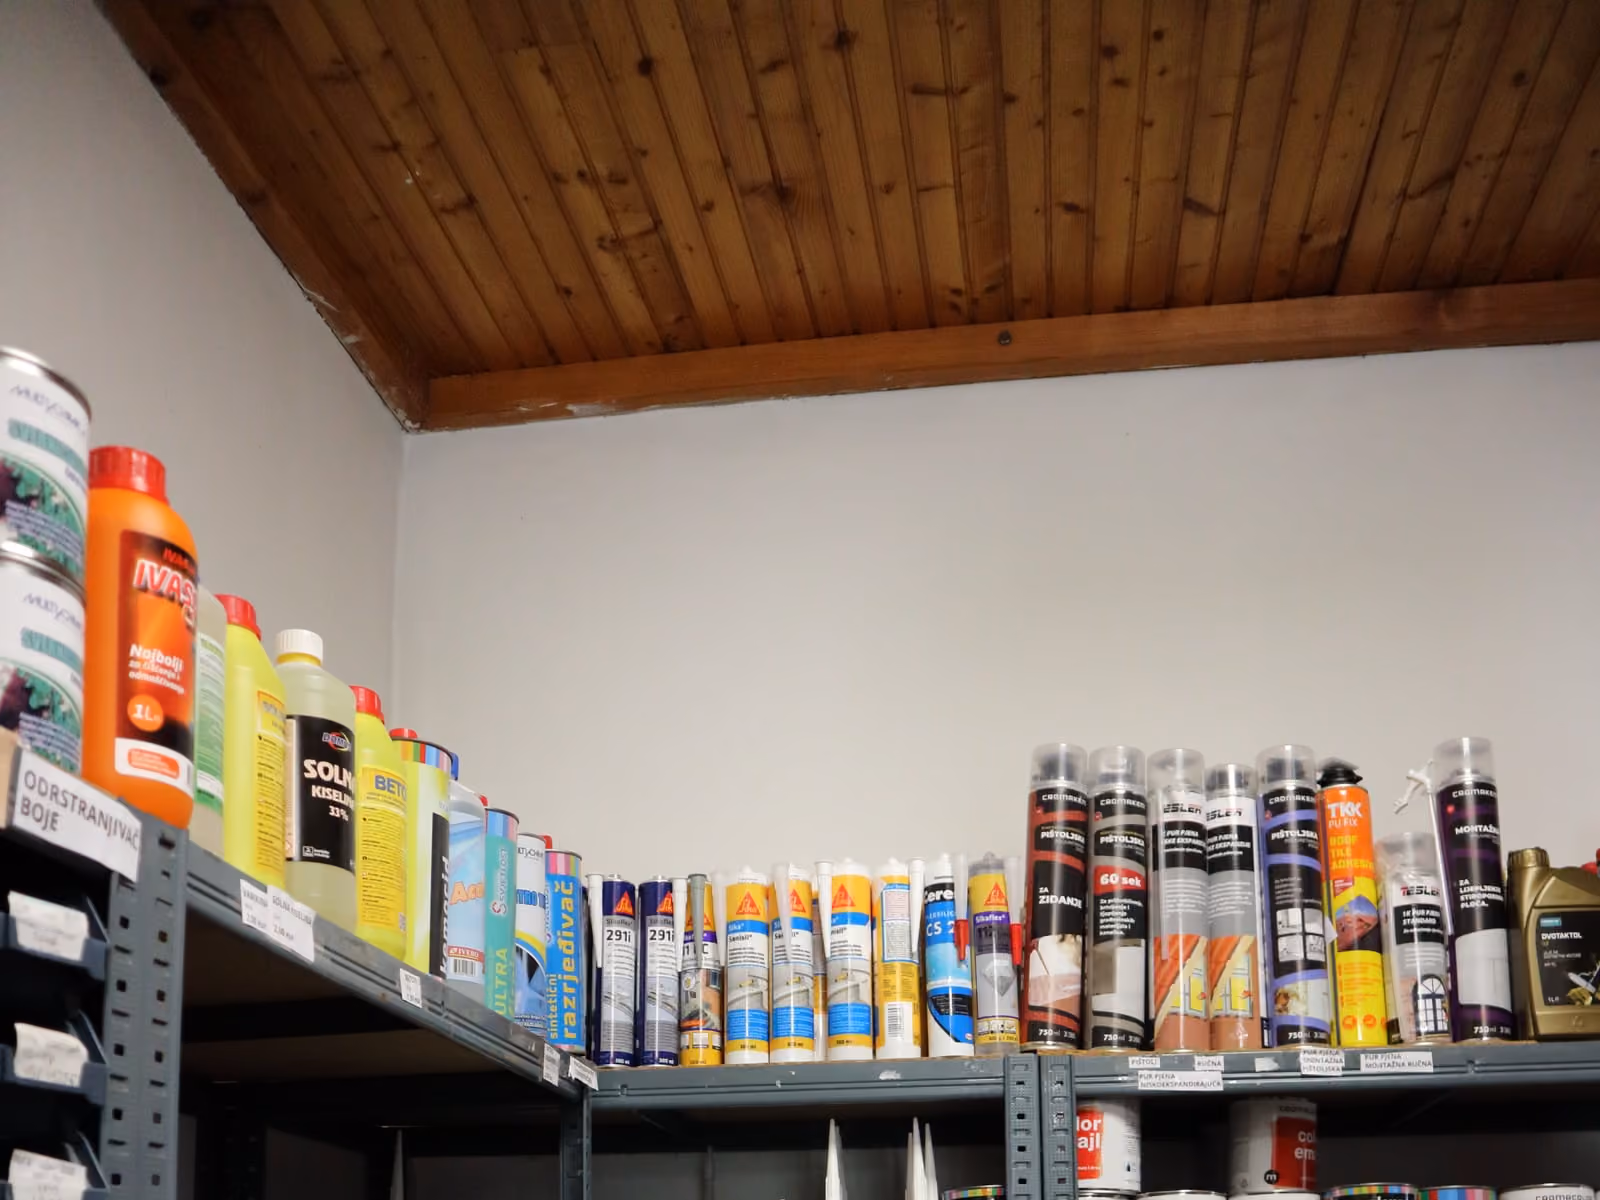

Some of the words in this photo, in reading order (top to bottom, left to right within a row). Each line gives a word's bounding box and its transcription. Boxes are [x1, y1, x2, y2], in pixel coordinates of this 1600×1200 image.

[20, 796, 60, 833] BOJE
[1100, 873, 1119, 886] 60
[606, 929, 631, 943] 291i
[554, 880, 578, 1039] razrjeđivač
